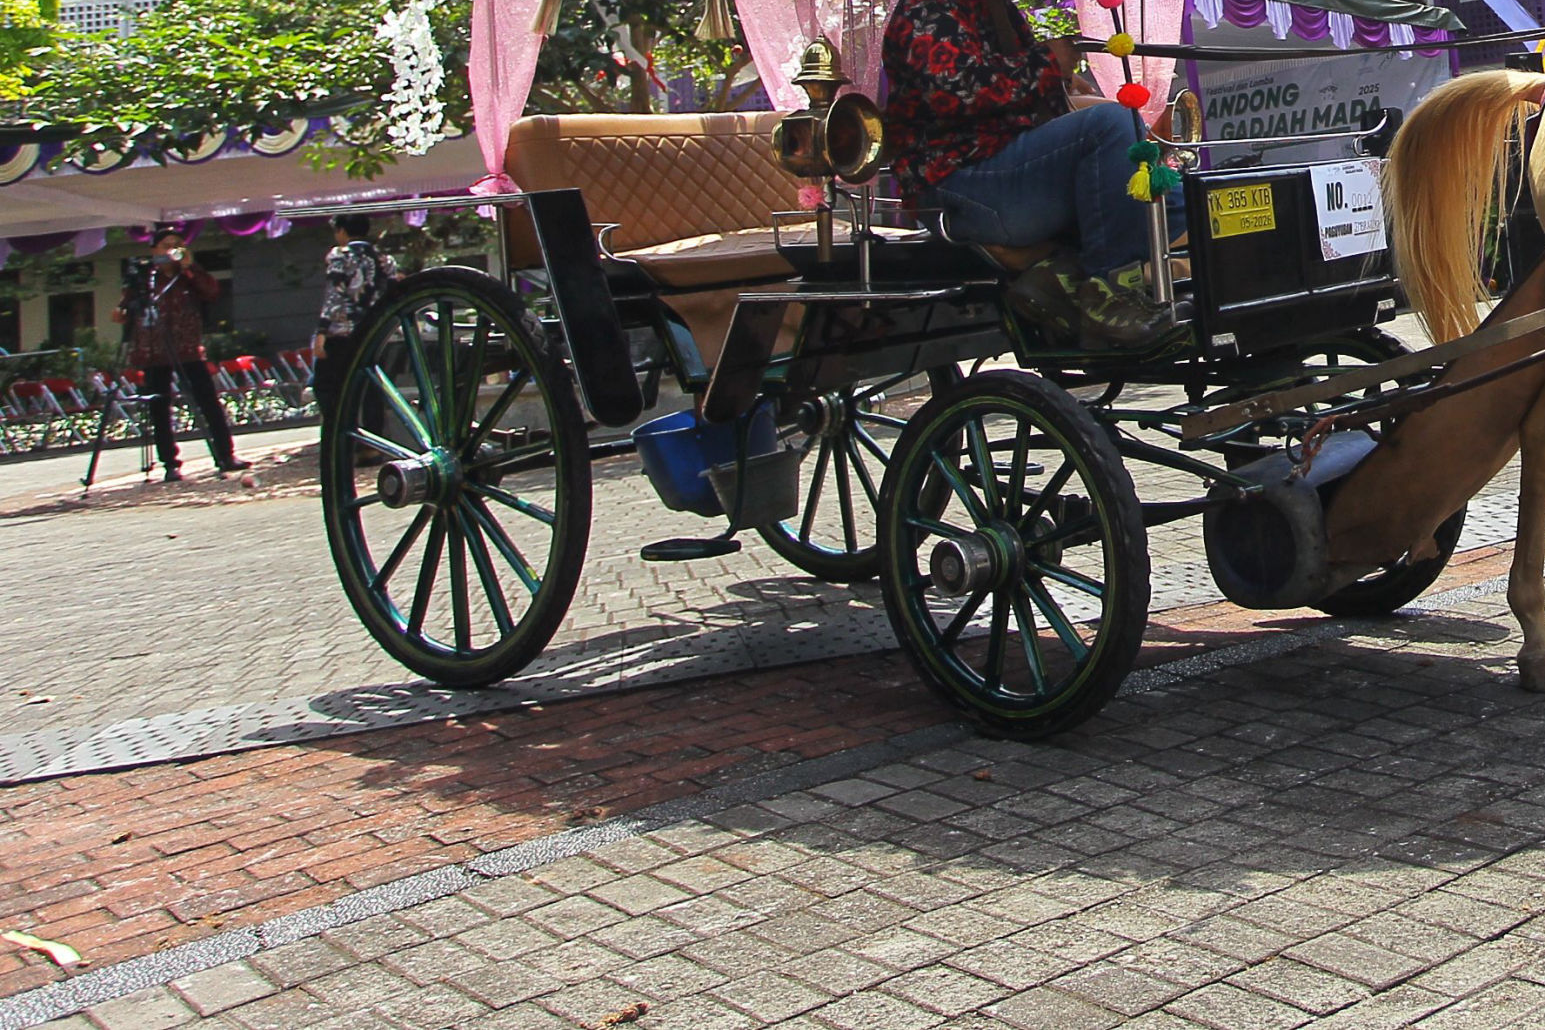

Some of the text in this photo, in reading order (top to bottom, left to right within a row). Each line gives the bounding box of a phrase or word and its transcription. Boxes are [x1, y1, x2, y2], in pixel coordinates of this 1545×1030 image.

[1206, 83, 1300, 120] ANDONG
[1358, 83, 1380, 96] 2025
[1220, 109, 1307, 140] GADJAH
[1227, 190, 1248, 209] 365
[1251, 188, 1271, 207] KTB
[1326, 181, 1348, 212] NO.
